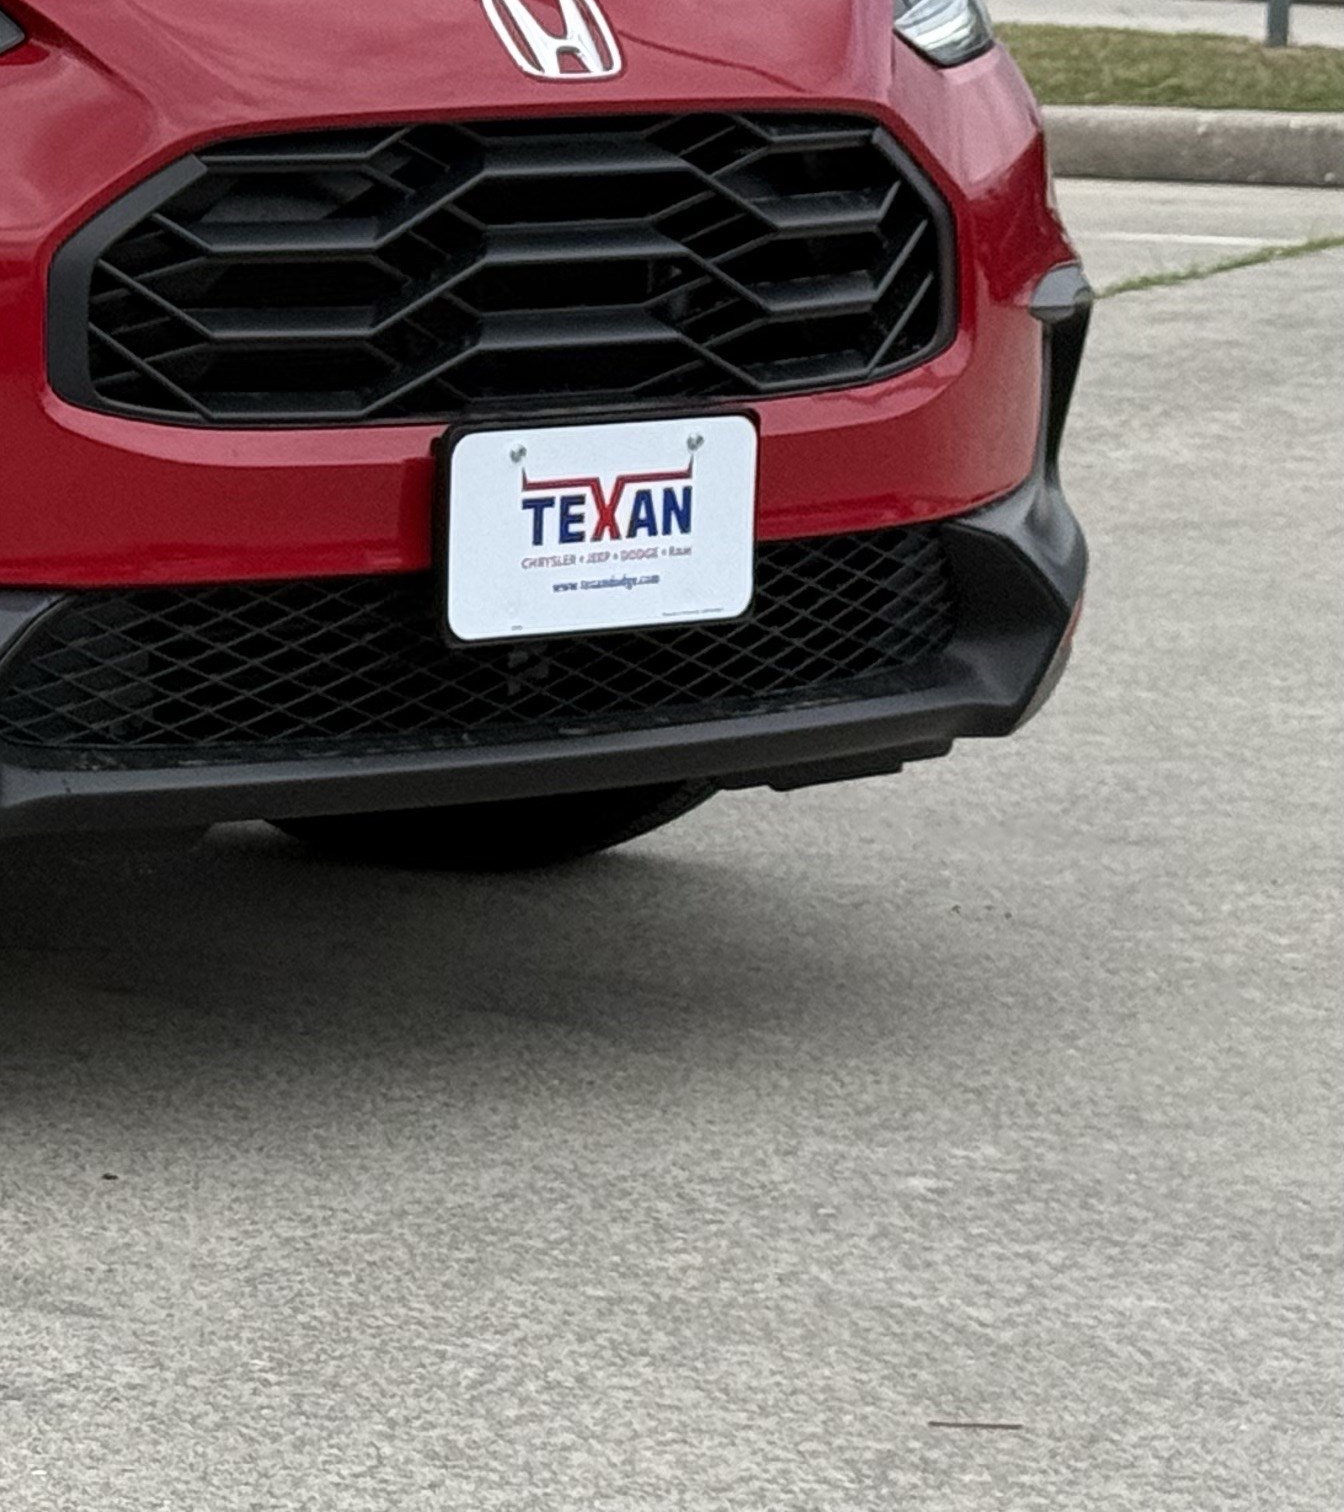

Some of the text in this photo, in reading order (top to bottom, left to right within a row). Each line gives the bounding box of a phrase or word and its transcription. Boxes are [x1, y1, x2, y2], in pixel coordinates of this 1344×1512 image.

[521, 475, 693, 546] TEXAN
[521, 554, 576, 569] CHRYSLER
[586, 551, 610, 564] JEEP
[620, 547, 659, 561] DODGE
